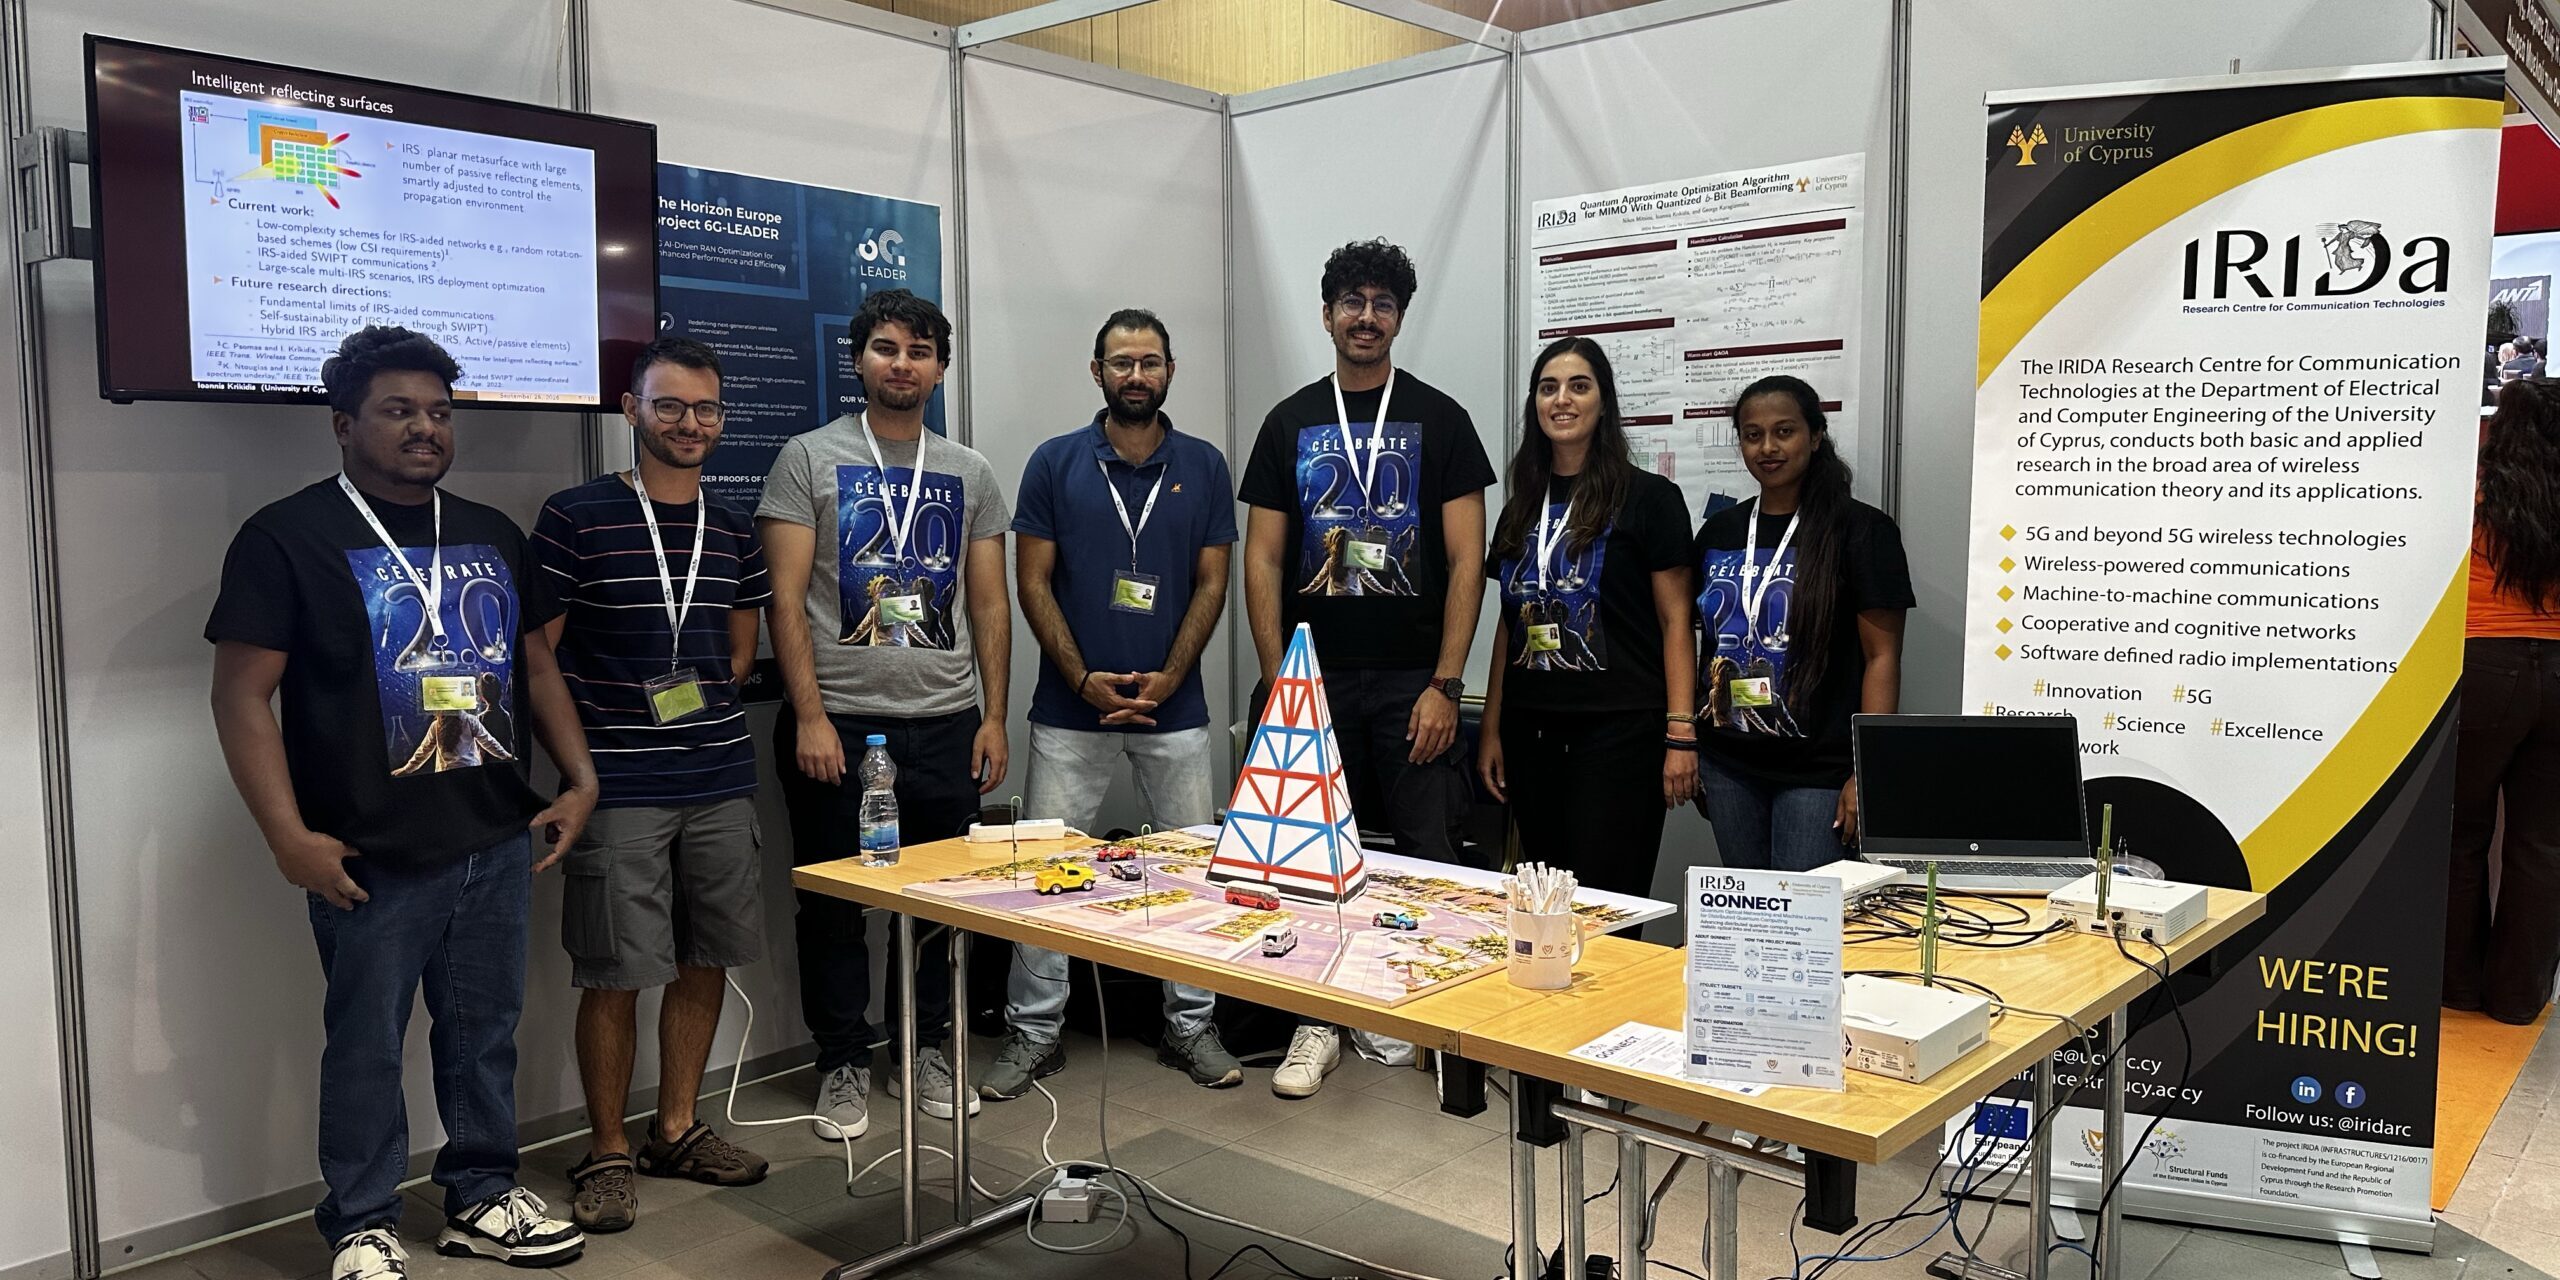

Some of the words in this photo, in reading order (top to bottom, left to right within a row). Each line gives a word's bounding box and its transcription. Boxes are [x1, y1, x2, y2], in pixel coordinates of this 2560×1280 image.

[192, 70, 265, 95] Intelligent
[271, 84, 335, 107] reflecting
[339, 96, 394, 114] surfaces
[2064, 123, 2155, 143] University
[427, 146, 458, 160] planar
[461, 153, 519, 168] metasurface
[521, 162, 542, 171] with
[544, 163, 567, 176] large
[2063, 145, 2084, 164] of
[2088, 144, 2153, 165] Cyprus
[402, 161, 440, 173] number
[443, 166, 454, 174] of
[457, 168, 492, 180] passive
[494, 172, 538, 188] reflecting
[540, 178, 583, 192] elements,
[402, 176, 440, 191] smartly
[442, 180, 484, 194] adjusted
[487, 185, 498, 195] to
[500, 188, 534, 200] control
[536, 190, 552, 202] the
[403, 192, 462, 206] propagation
[1580, 198, 1619, 212] Quantum
[1621, 190, 1678, 206] Approximate
[1681, 179, 1738, 197] Optimization
[1742, 172, 1790, 189] Algorithm
[1584, 210, 1595, 218] for
[1598, 204, 1628, 216] MIMO
[1631, 201, 1652, 213] With
[1656, 194, 1702, 210] Quantized
[1730, 183, 1794, 199] Beamforming
[228, 197, 276, 213] Current
[280, 205, 314, 217] work:
[658, 196, 677, 210] he
[680, 198, 732, 217] Horizon
[736, 206, 782, 225] Europe
[704, 219, 779, 240] 6G-LEADER
[858, 227, 906, 266] 6G
[860, 264, 907, 281] LEADER
[231, 276, 273, 290] Future
[277, 282, 327, 293] research
[331, 283, 391, 298] directions:
[2182, 304, 2230, 314] Research
[2232, 303, 2266, 313] Centre
[2268, 303, 2284, 312] for
[2286, 300, 2370, 311] Communication
[2372, 298, 2446, 309] Technologies
[2020, 358, 2053, 375] The
[2058, 358, 2106, 374] IRIDA
[2112, 356, 2193, 374] Research
[2199, 356, 2262, 373] Centre
[2266, 354, 2294, 372] for
[2298, 352, 2460, 371] Communication
[2019, 382, 2137, 403] Technologies
[2142, 384, 2160, 398] at
[2164, 381, 2196, 398] the
[2201, 382, 2318, 401] Department
[2323, 379, 2345, 396] of
[2349, 378, 2440, 396] Electrical
[2018, 407, 2052, 424] and
[2057, 407, 2149, 427] Computer
[2153, 406, 2266, 427] Engineering
[2272, 405, 2293, 422] of
[2296, 405, 2329, 422] the
[2335, 405, 2436, 426] University
[2017, 431, 2037, 448] of
[2039, 432, 2105, 452] Cyprus,
[2109, 431, 2194, 448] conducts
[2200, 431, 2244, 448] both
[2250, 431, 2298, 448] basic
[2303, 431, 2341, 448] and
[2346, 430, 2422, 452] applied
[2016, 456, 2090, 472] research
[2096, 456, 2112, 472] in
[2117, 456, 2147, 472] the
[2152, 456, 2207, 473] broad
[2212, 460, 2252, 473] area
[2257, 456, 2278, 473] of
[2281, 456, 2360, 473] wireless
[2015, 481, 2156, 497] communication
[2161, 481, 2224, 502] theory
[2228, 481, 2264, 498] and
[2269, 482, 2291, 498] its
[2296, 482, 2422, 502] applications.
[2025, 525, 2050, 541] 5G
[2054, 525, 2088, 542] and
[2093, 525, 2162, 546] beyond
[2167, 527, 2193, 544] 5G
[2198, 528, 2273, 545] wireless
[2278, 528, 2406, 551] technologies
[2024, 555, 2184, 576] Wireless-powered
[2189, 560, 2350, 578] communications
[2023, 585, 2212, 605] Machine-to-machine
[2217, 592, 2379, 610] communications
[2021, 614, 2130, 634] Cooperative
[2134, 618, 2169, 634] and
[2174, 620, 2261, 640] cognitive
[2266, 623, 2356, 641] networks
[2020, 644, 2099, 662] Software
[2103, 646, 2173, 664] defined
[2179, 649, 2226, 666] radio
[2231, 651, 2398, 674] implementations
[2034, 679, 2142, 701] #Innovation
[2173, 686, 2212, 705] #5G
[2103, 713, 2186, 734] #Science
[2210, 718, 2323, 741] #Excellence
[1700, 892, 1792, 912] QONNECT
[2257, 1009, 2417, 1058] HIRING!
[2246, 1103, 2304, 1124] Follow
[2309, 1114, 2334, 1128] us:
[2338, 1116, 2411, 1137] @iridarc
[2168, 1165, 2205, 1176] Structural
[2205, 1169, 2228, 1180] Funds
